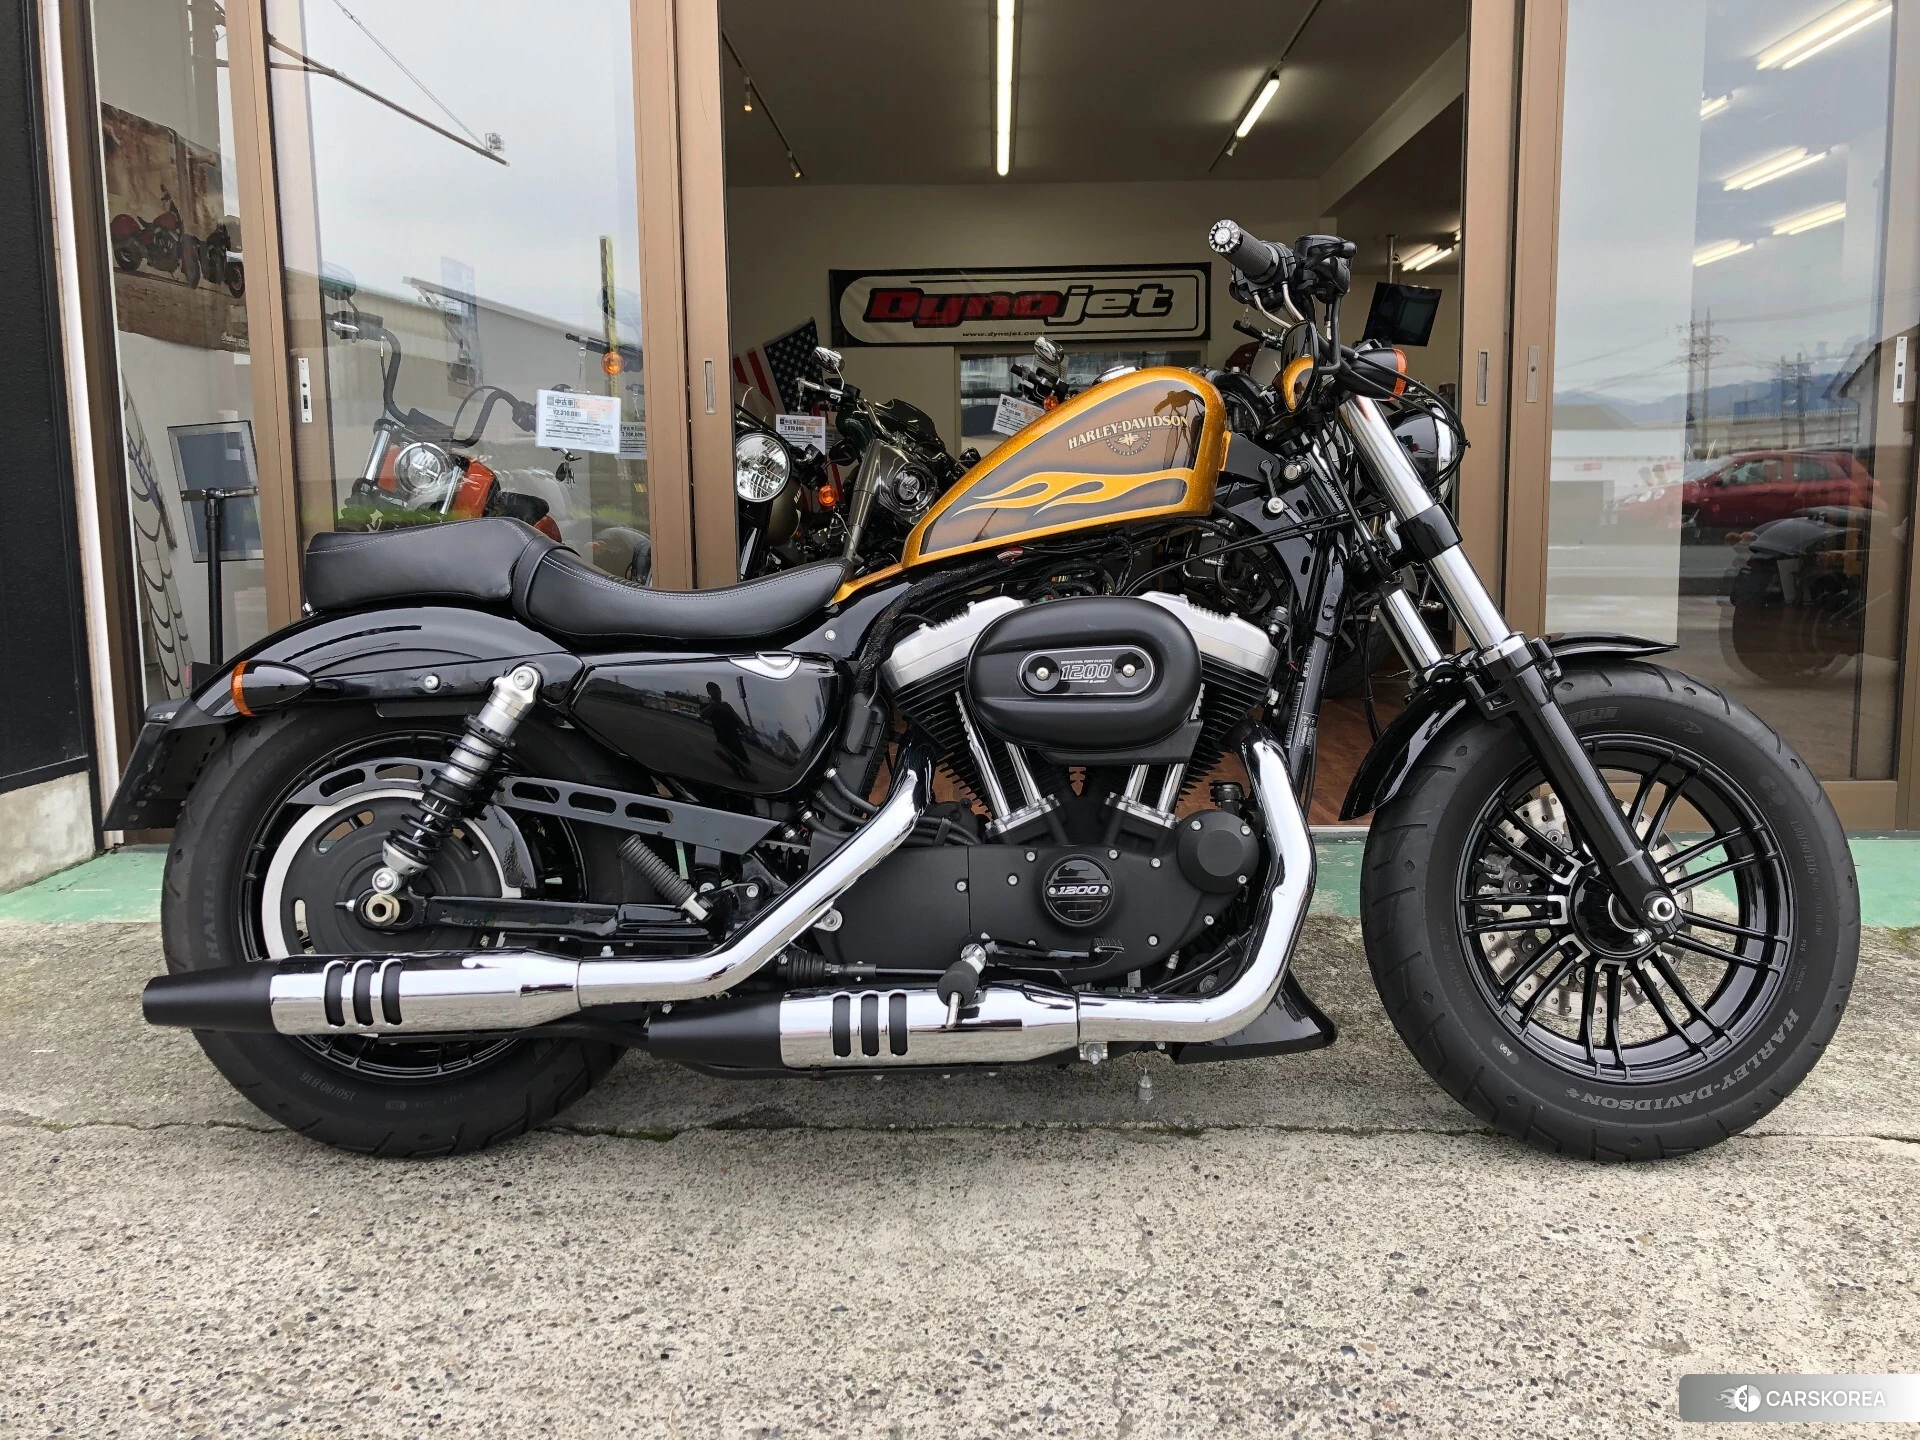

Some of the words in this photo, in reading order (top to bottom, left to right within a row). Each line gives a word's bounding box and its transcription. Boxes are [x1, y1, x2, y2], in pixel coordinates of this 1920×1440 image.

[863, 284, 1173, 328] Dynojet
[1068, 415, 1188, 450] HARLEY-DAVIDSON
[1060, 663, 1113, 680] 1200
[1057, 885, 1100, 895] 1200
[1581, 1008, 1799, 1111] HARLEY-DAVIDSON
